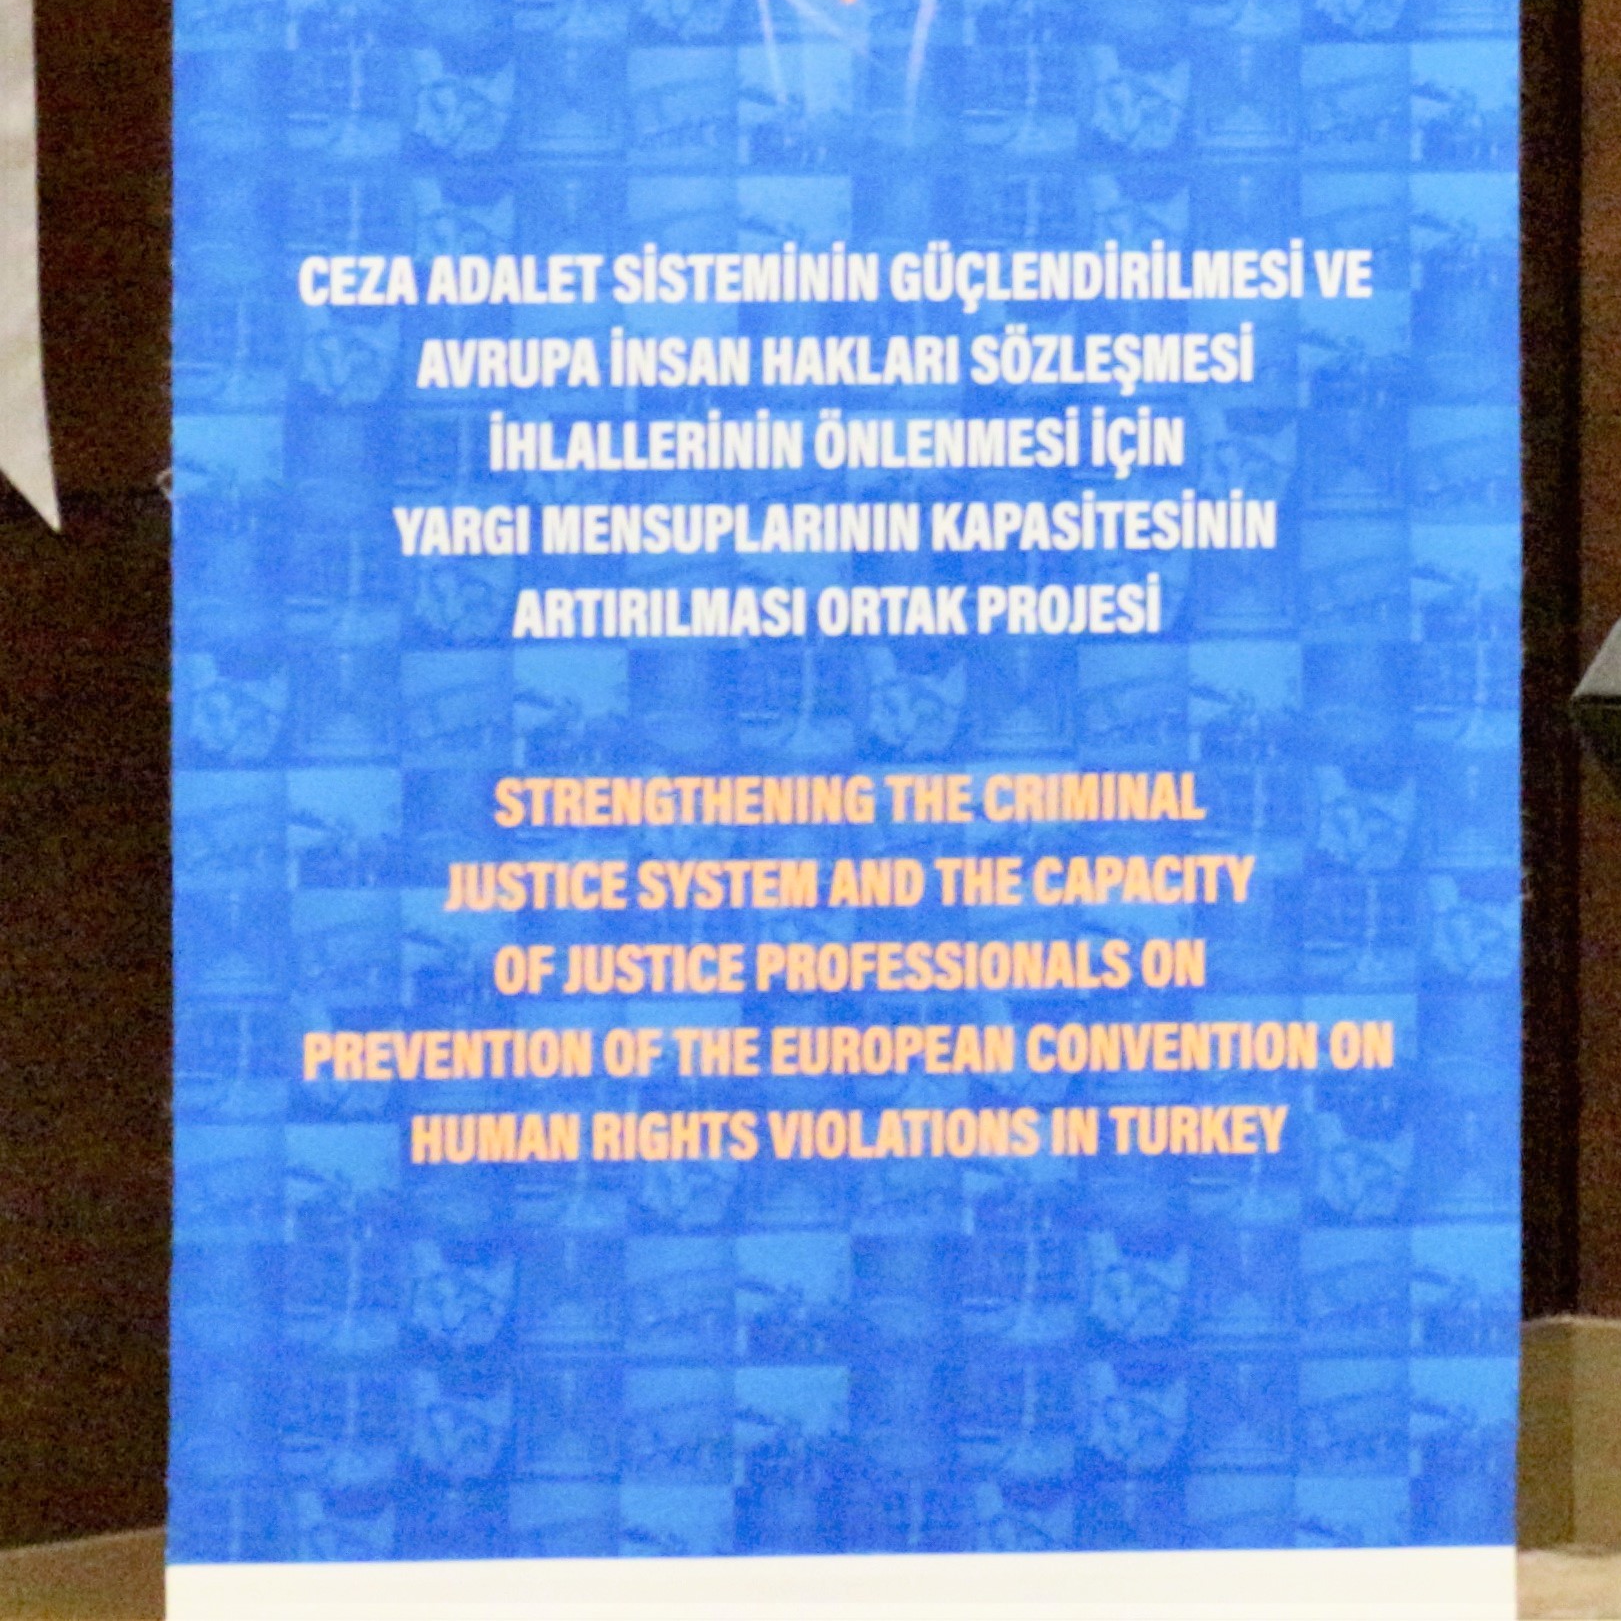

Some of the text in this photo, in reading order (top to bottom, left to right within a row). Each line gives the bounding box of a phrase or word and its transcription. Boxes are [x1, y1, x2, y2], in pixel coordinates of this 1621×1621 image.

[299, 239, 1372, 313] CEZA ADALET SİSTEMİNİN GÜÇLENDİRİLMESİ VE
[417, 322, 1253, 396] AVRUPA İNSAN HAKLARI SÖZLEŞMESİ
[491, 406, 1183, 478] İHLALLERİNİN ÖNLENMESİ İÇİN
[394, 489, 1276, 555] YARGI MENSUPLARININ KAPASİTESİNİN
[513, 573, 1160, 637] ARTIRILMASI ORTAK PROJESİ
[495, 772, 1206, 827] STRENGTHENING THE CRIMINAL
[444, 854, 1255, 912] JUSTICE SYSTEM AND THE CAPACITY
[494, 938, 1205, 994] OF JUSTICE PROFESSIONALS ON
[303, 1020, 1394, 1081] PREVENTION OF THE EUROPEAN CONVENTION ON
[412, 1105, 1287, 1163] HUMAN RIGHTS VIOLATIONS IN TURKEY
